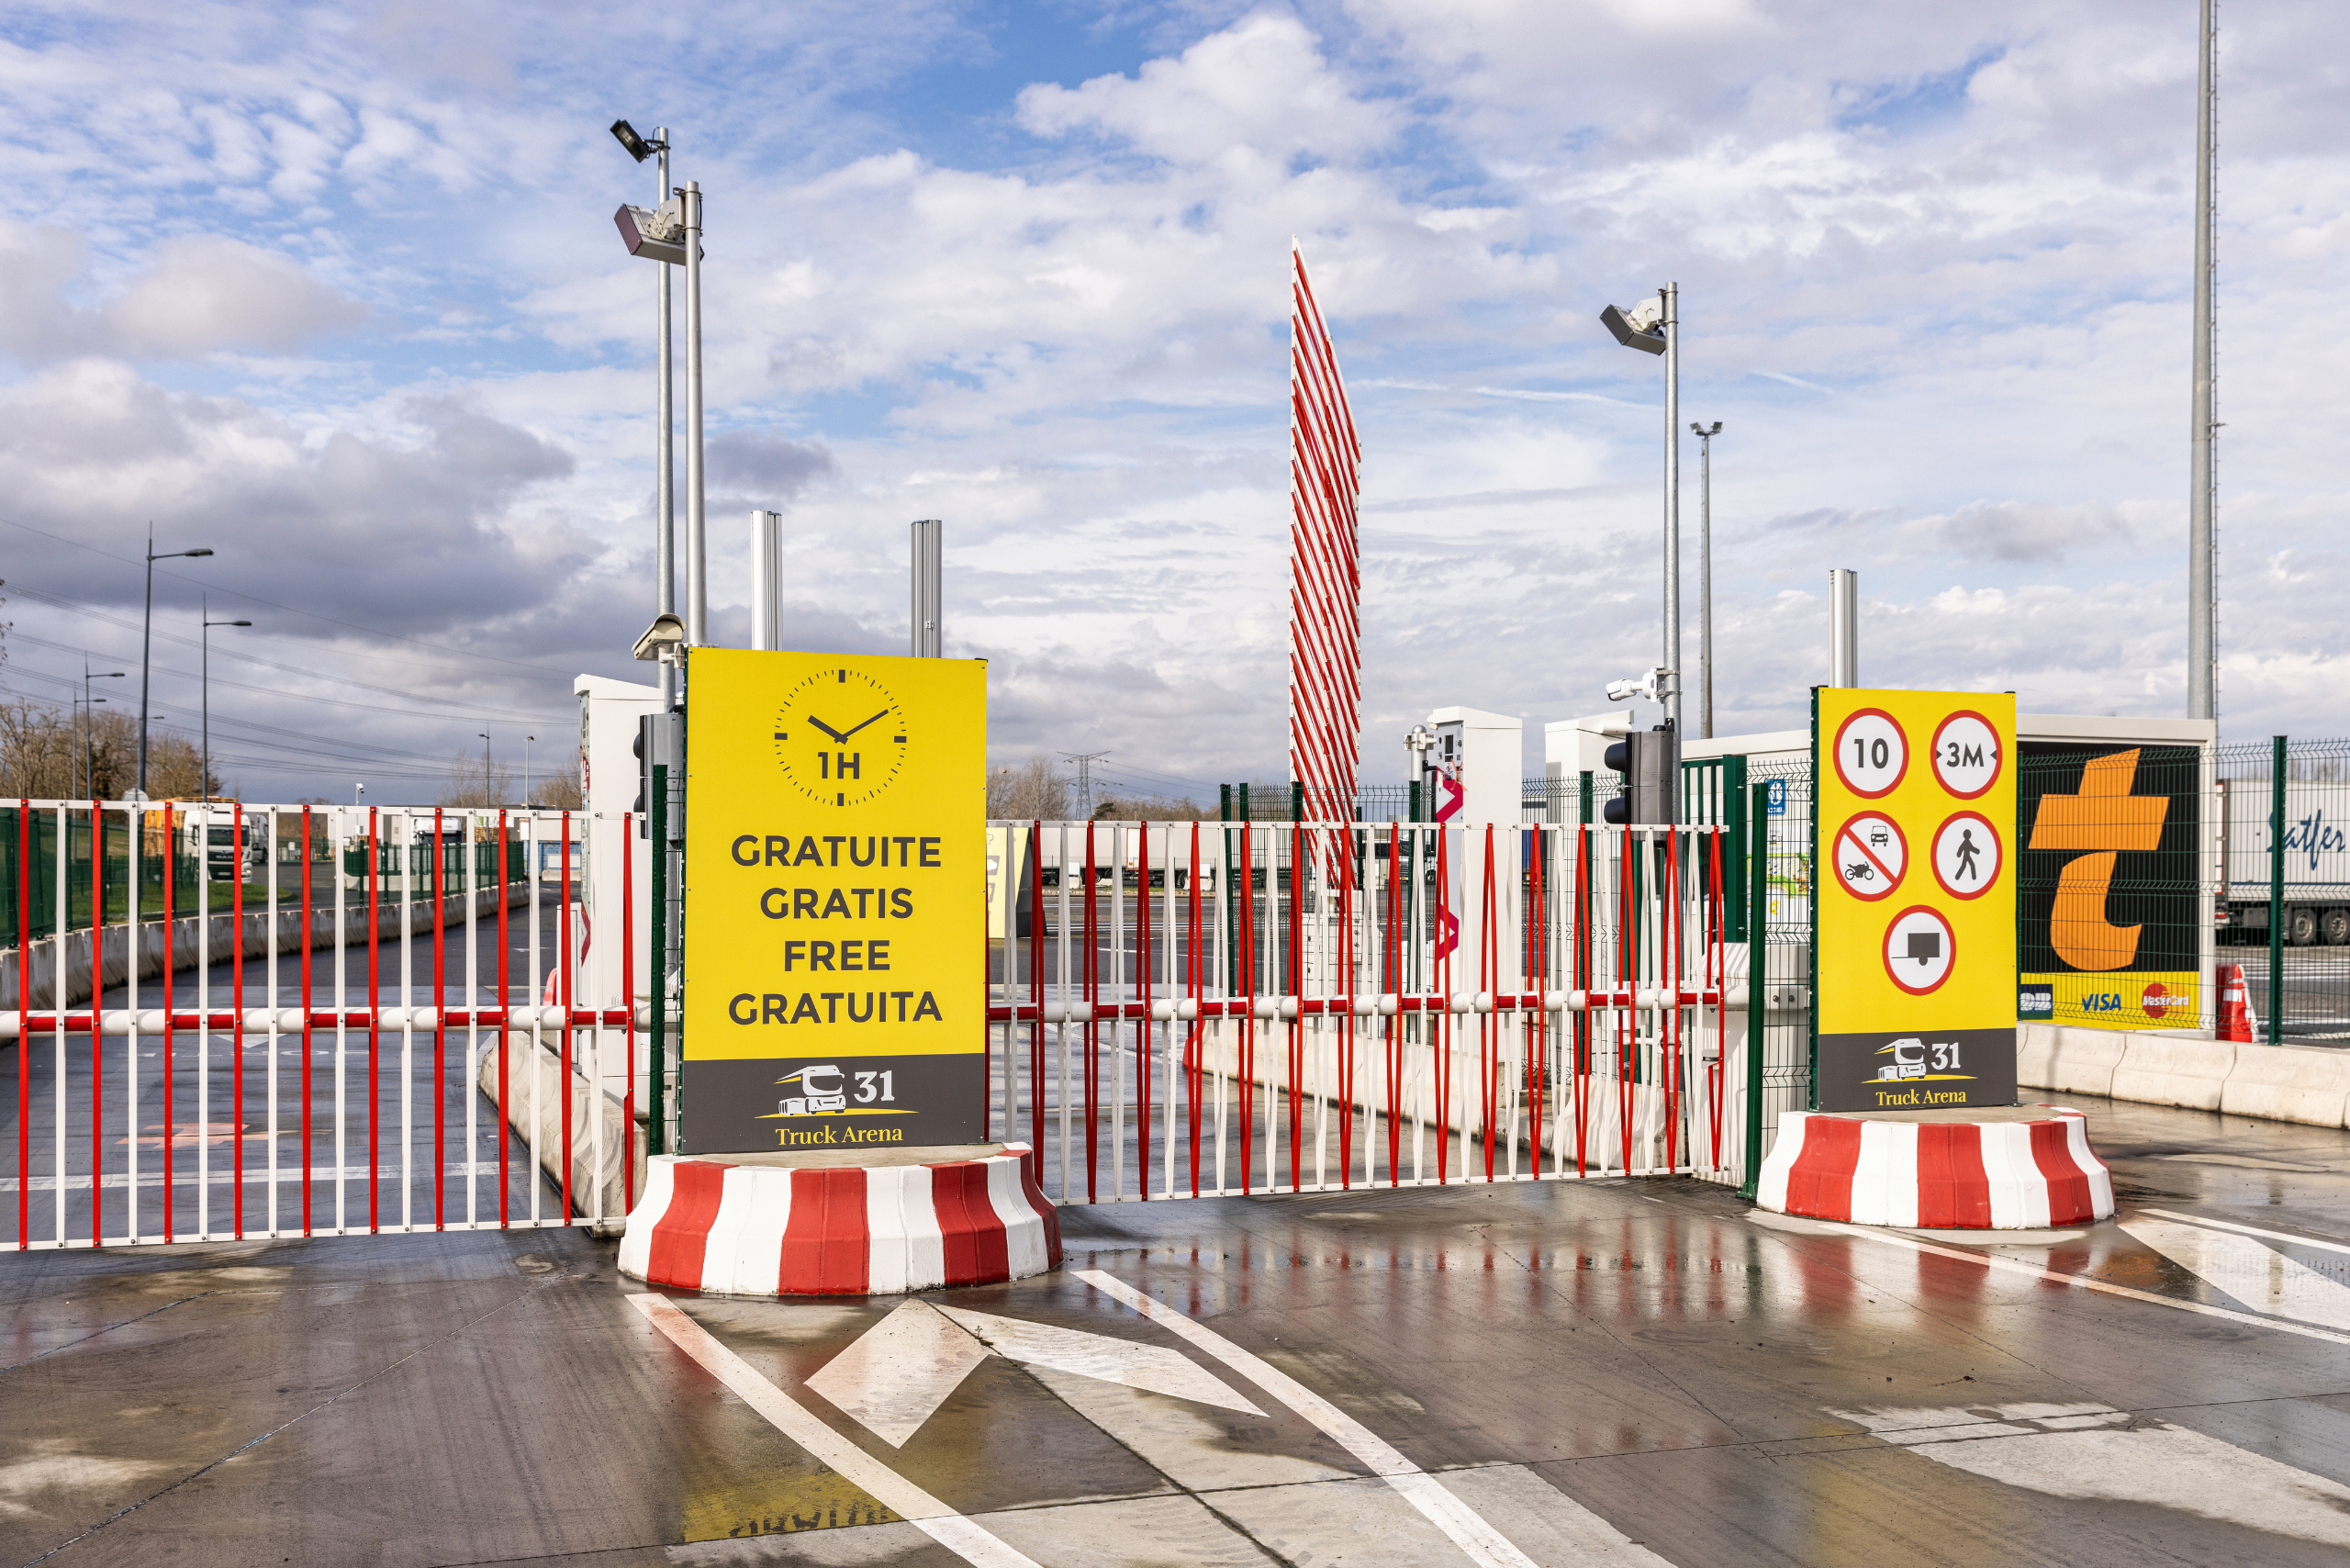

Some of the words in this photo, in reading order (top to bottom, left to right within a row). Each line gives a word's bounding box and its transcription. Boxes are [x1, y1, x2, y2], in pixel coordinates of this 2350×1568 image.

[817, 751, 860, 780] 1H
[1853, 738, 1889, 769] 10
[1946, 742, 1985, 767] 3M
[731, 834, 942, 868] GRATUITE
[760, 887, 913, 920] GRATIS
[784, 939, 890, 972] FREE
[728, 991, 944, 1025] GRATUITA
[2082, 993, 2122, 1012] VISA
[2143, 994, 2189, 1006] MasterCard
[1931, 1042, 1962, 1070] 31
[853, 1070, 895, 1103] 31
[1874, 1089, 1919, 1106] Truck
[1921, 1089, 1968, 1105] Arena
[775, 1125, 838, 1147] Truck
[841, 1126, 904, 1146] Arena
